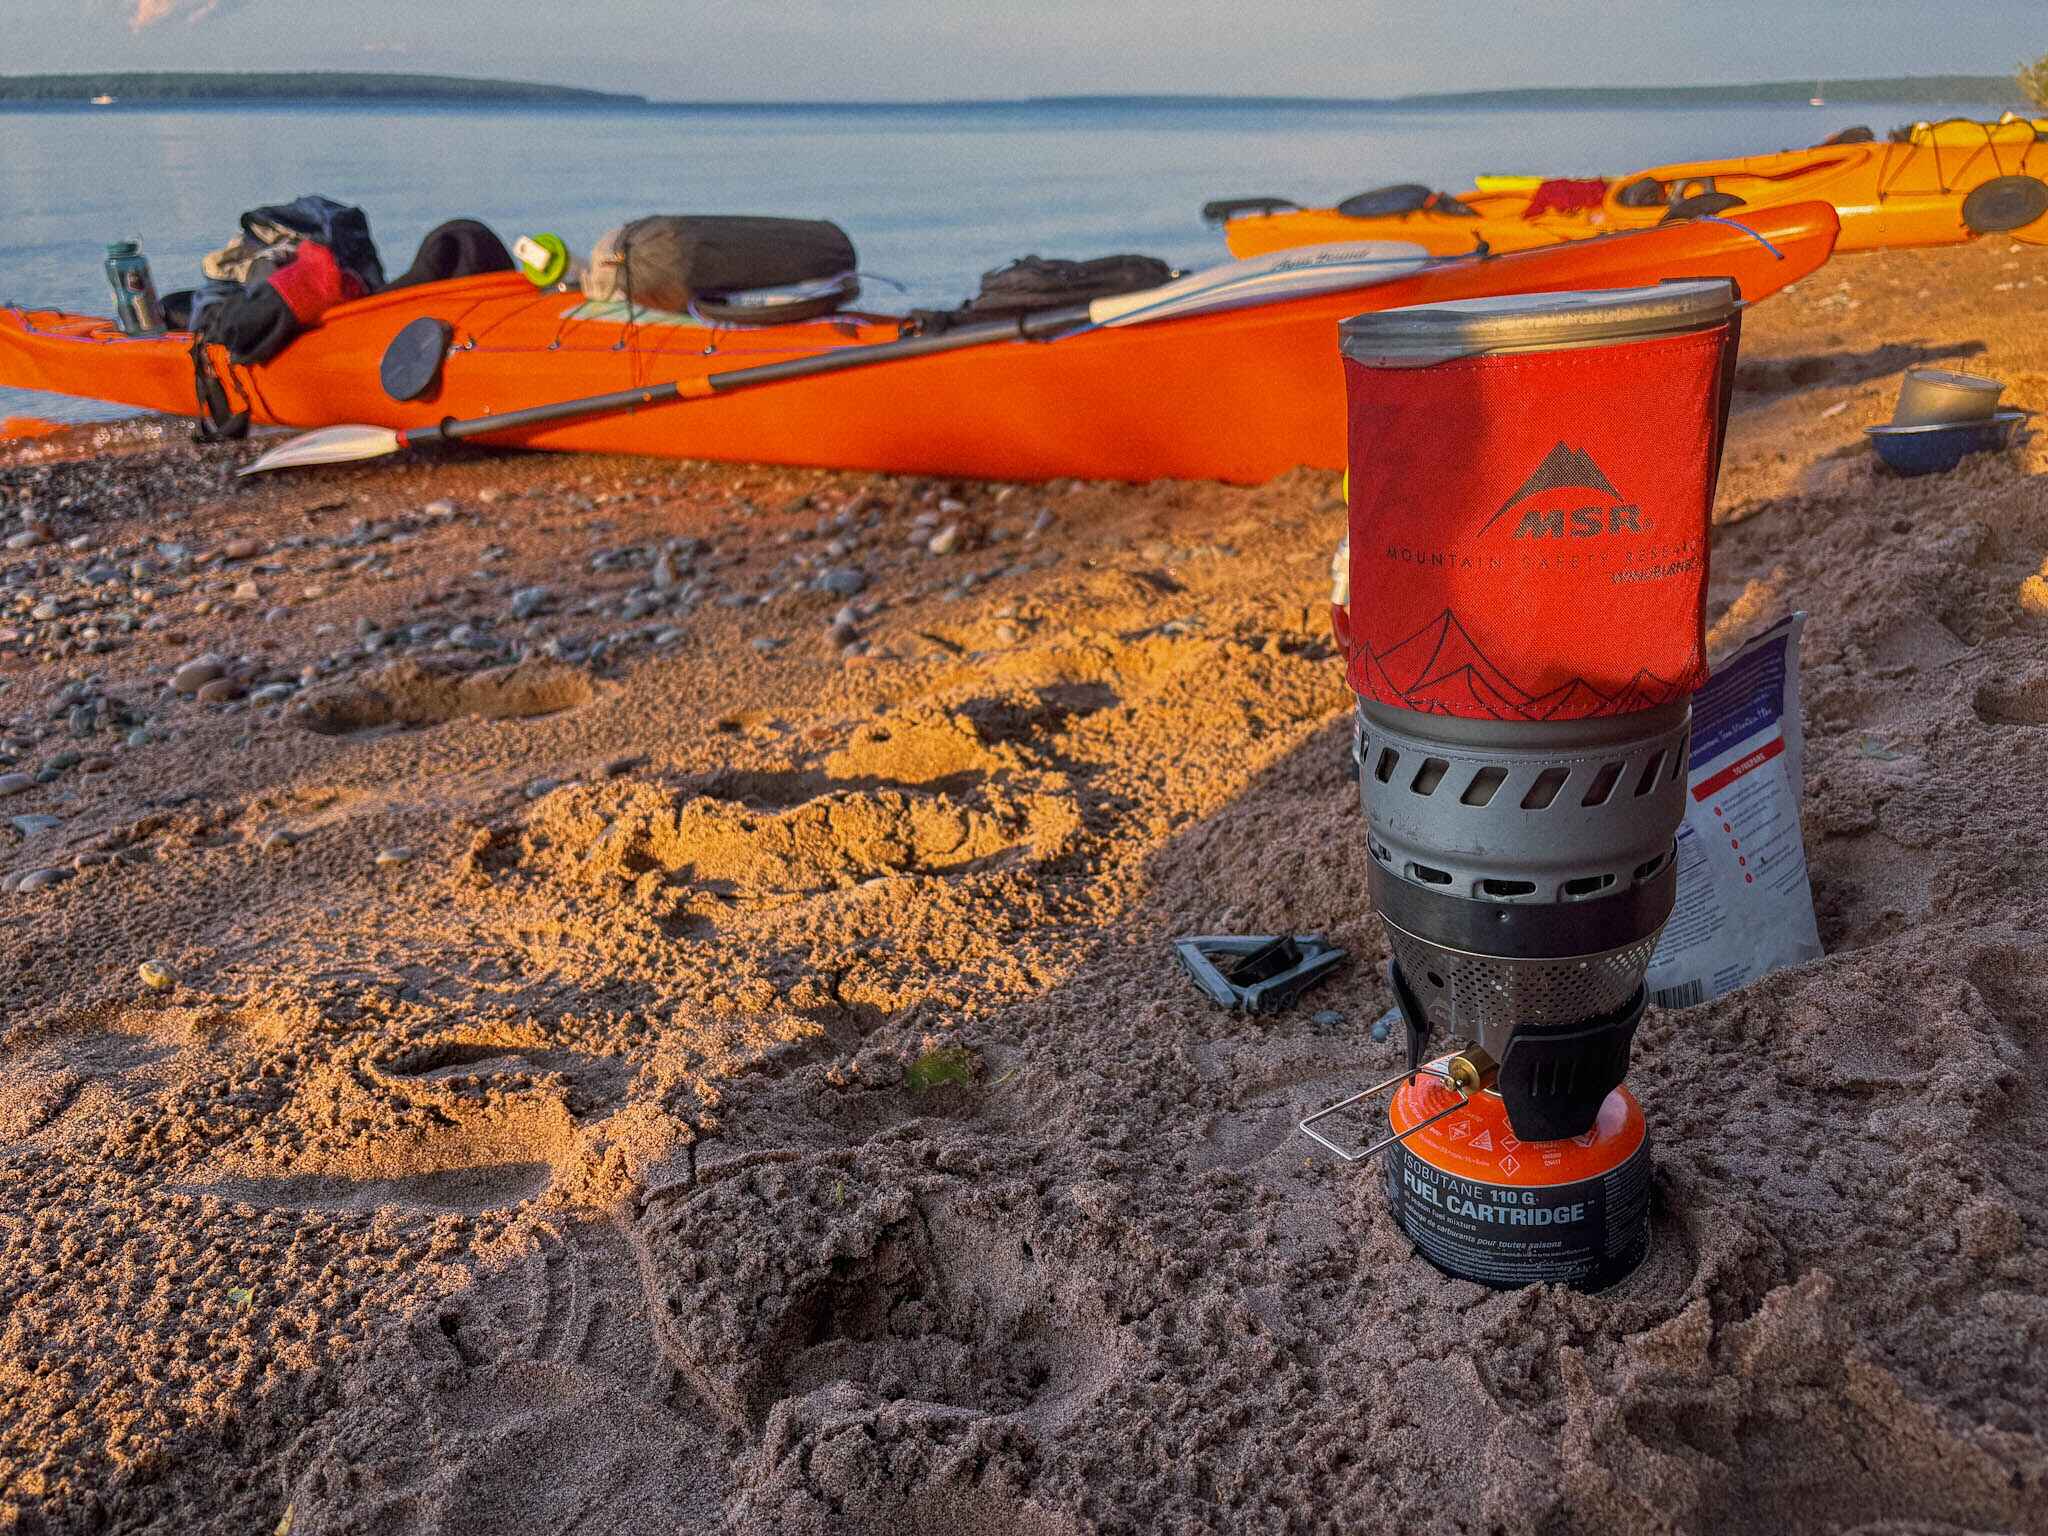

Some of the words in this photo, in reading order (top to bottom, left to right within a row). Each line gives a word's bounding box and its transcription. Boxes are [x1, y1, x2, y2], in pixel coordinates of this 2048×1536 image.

[1512, 504, 1643, 541] MSR
[1386, 547, 1502, 569] MOUNTAIN
[1403, 1151, 1484, 1200] ISOBUTANE
[1489, 1189, 1518, 1205] 110
[1403, 1167, 1444, 1208] FUEL
[1446, 1195, 1585, 1227] CARTRIDGE
[1436, 1223, 1476, 1243] carburants
[1476, 1237, 1497, 1249] pour
[1498, 1239, 1527, 1250] toutes
[1446, 1216, 1477, 1232] mixture
